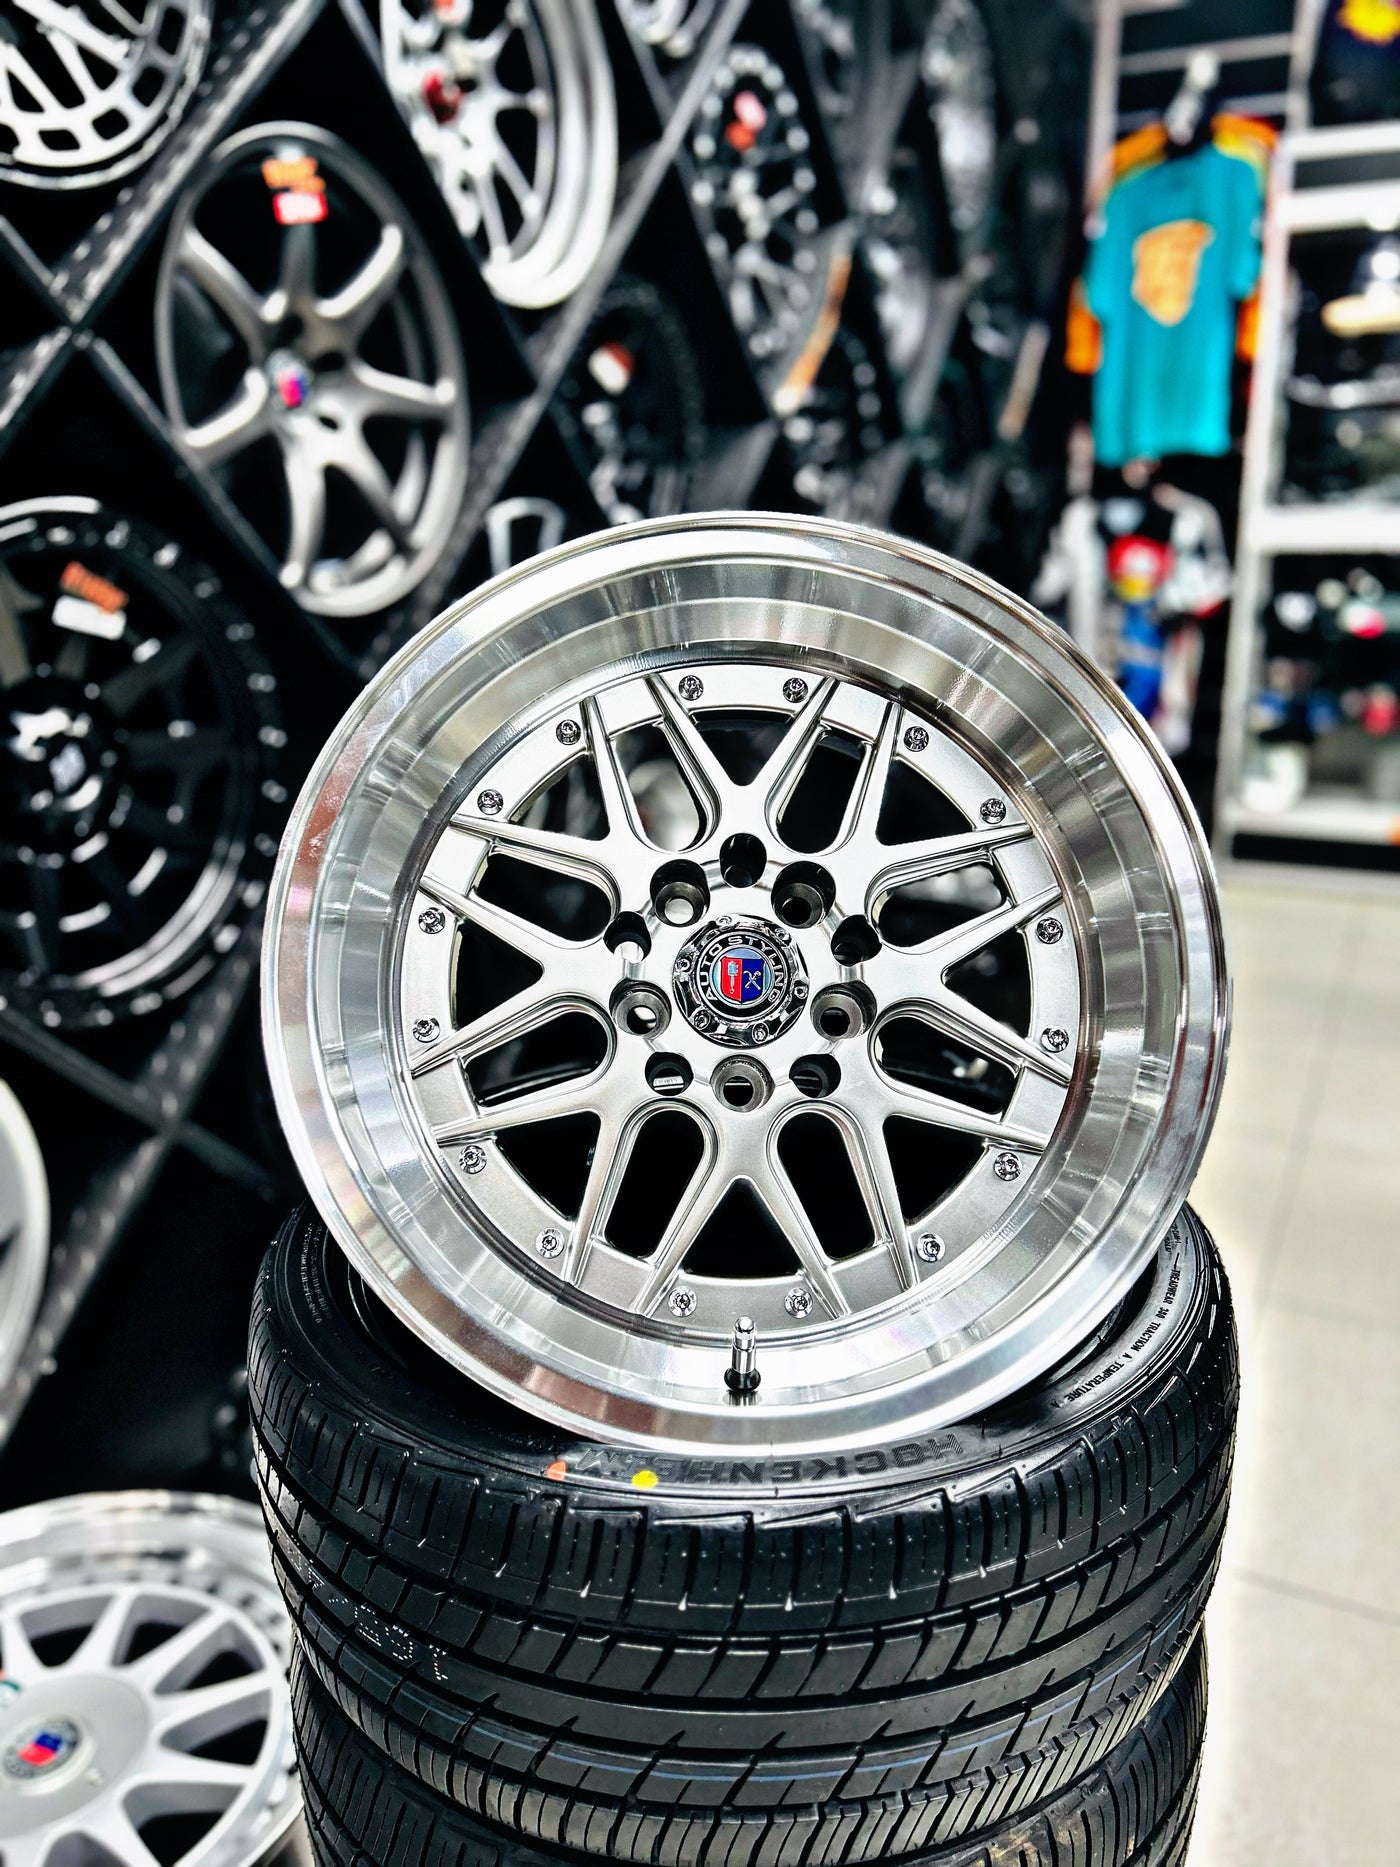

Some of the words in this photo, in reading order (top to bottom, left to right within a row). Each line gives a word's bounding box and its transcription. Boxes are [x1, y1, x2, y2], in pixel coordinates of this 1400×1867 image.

[700, 944, 722, 1001] AUTO
[728, 935, 785, 1002] STYLING
[1163, 1269, 1181, 1308] TREADWEAR
[1122, 1352, 1133, 1360] A
[1132, 1321, 1161, 1352] TRACTION
[1064, 1361, 1124, 1402] TEMPERATURE
